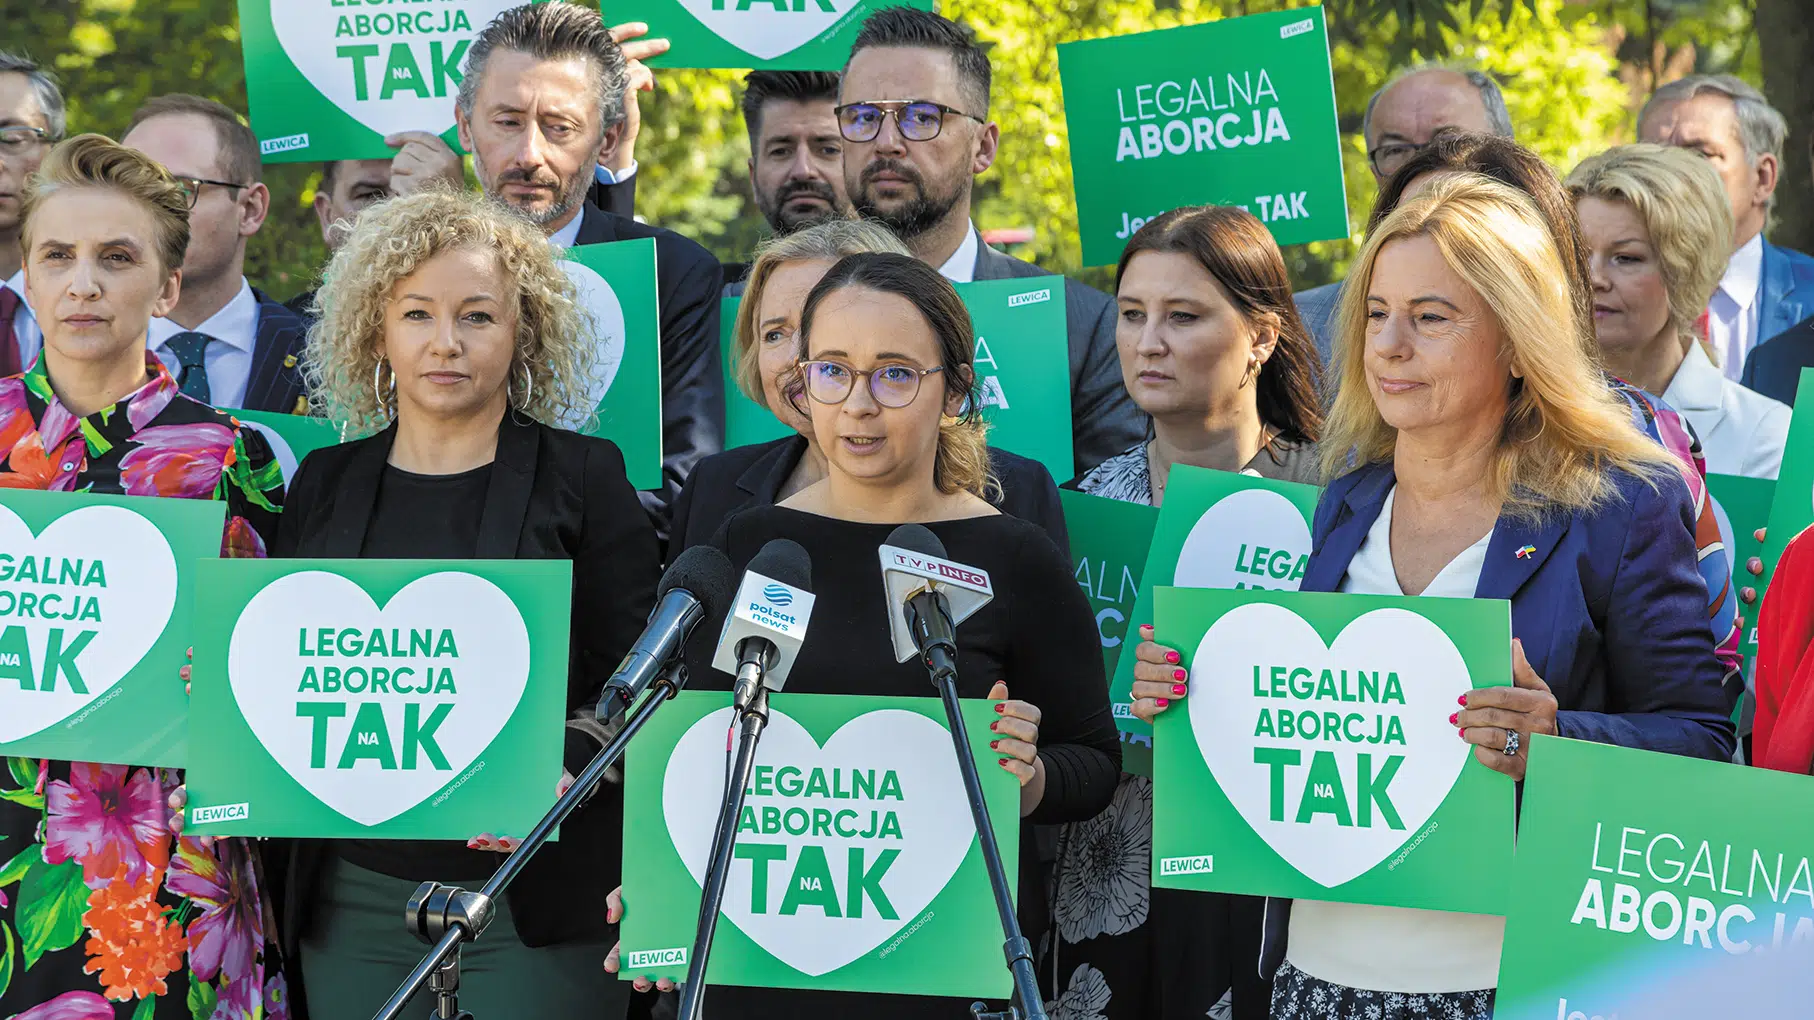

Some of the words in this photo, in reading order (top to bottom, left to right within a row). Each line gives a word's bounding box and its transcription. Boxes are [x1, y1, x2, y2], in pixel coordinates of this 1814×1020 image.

[335, 10, 472, 37] ABORCJA
[336, 40, 472, 101] TAK
[393, 67, 412, 79] NA
[1117, 68, 1279, 122] LEGALNA
[263, 136, 307, 152] LEWICA
[1116, 107, 1291, 162] ABORCJA
[1255, 191, 1309, 222] TAK
[1011, 291, 1048, 304] LEWICA
[896, 554, 936, 571] TVP
[940, 564, 986, 586] INFO
[1235, 543, 1309, 581] LEGA
[749, 602, 796, 625] polsat
[752, 613, 789, 632] news
[299, 627, 459, 659] LEGALNA
[0, 653, 20, 667] NA
[297, 666, 457, 694] ABORCJA
[1253, 665, 1407, 705] LEGALNA
[296, 701, 456, 771] TAK
[357, 732, 379, 746] NA
[1253, 708, 1407, 745] ABORCJA
[431, 760, 486, 807] @legalna.aborcja
[1253, 746, 1407, 831] TAK
[1313, 783, 1335, 799] NA
[195, 806, 246, 822] LEWICA
[737, 805, 903, 840] ABORCJA
[1387, 821, 1439, 872] @legalna.aborcja
[734, 842, 902, 921] TAK
[1163, 858, 1211, 873] LEWICA
[1591, 822, 1814, 909] LEGALNA
[800, 876, 822, 891] NA
[878, 910, 935, 960] @legalna.aborcja
[632, 949, 684, 965] LEWICA
